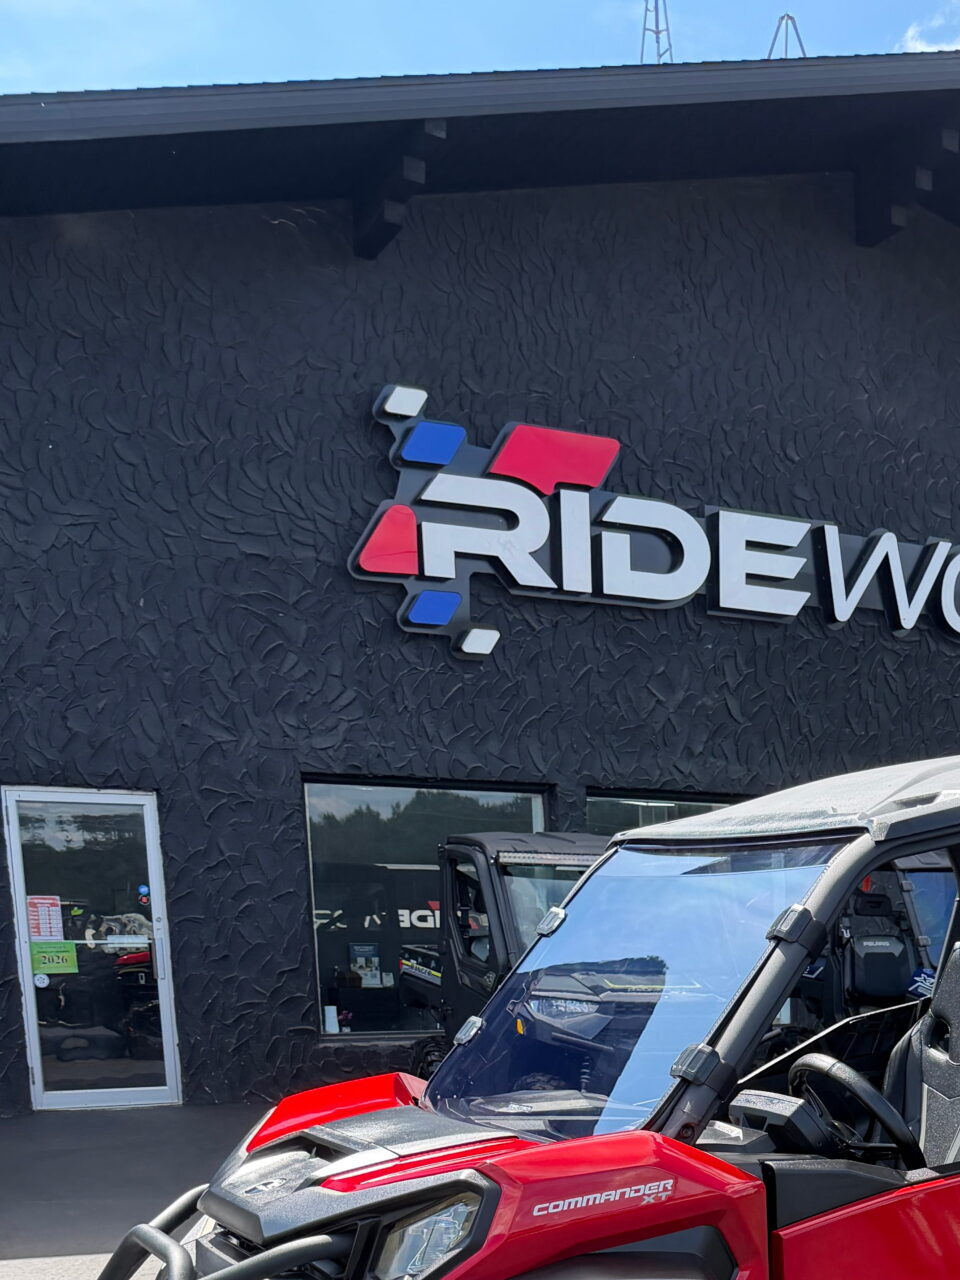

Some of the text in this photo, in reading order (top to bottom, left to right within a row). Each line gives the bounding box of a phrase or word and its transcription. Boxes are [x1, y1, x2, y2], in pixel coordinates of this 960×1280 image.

[41, 954, 68, 965] 2026
[533, 1179, 674, 1216] COMMANDER
[641, 1191, 672, 1205] XT
